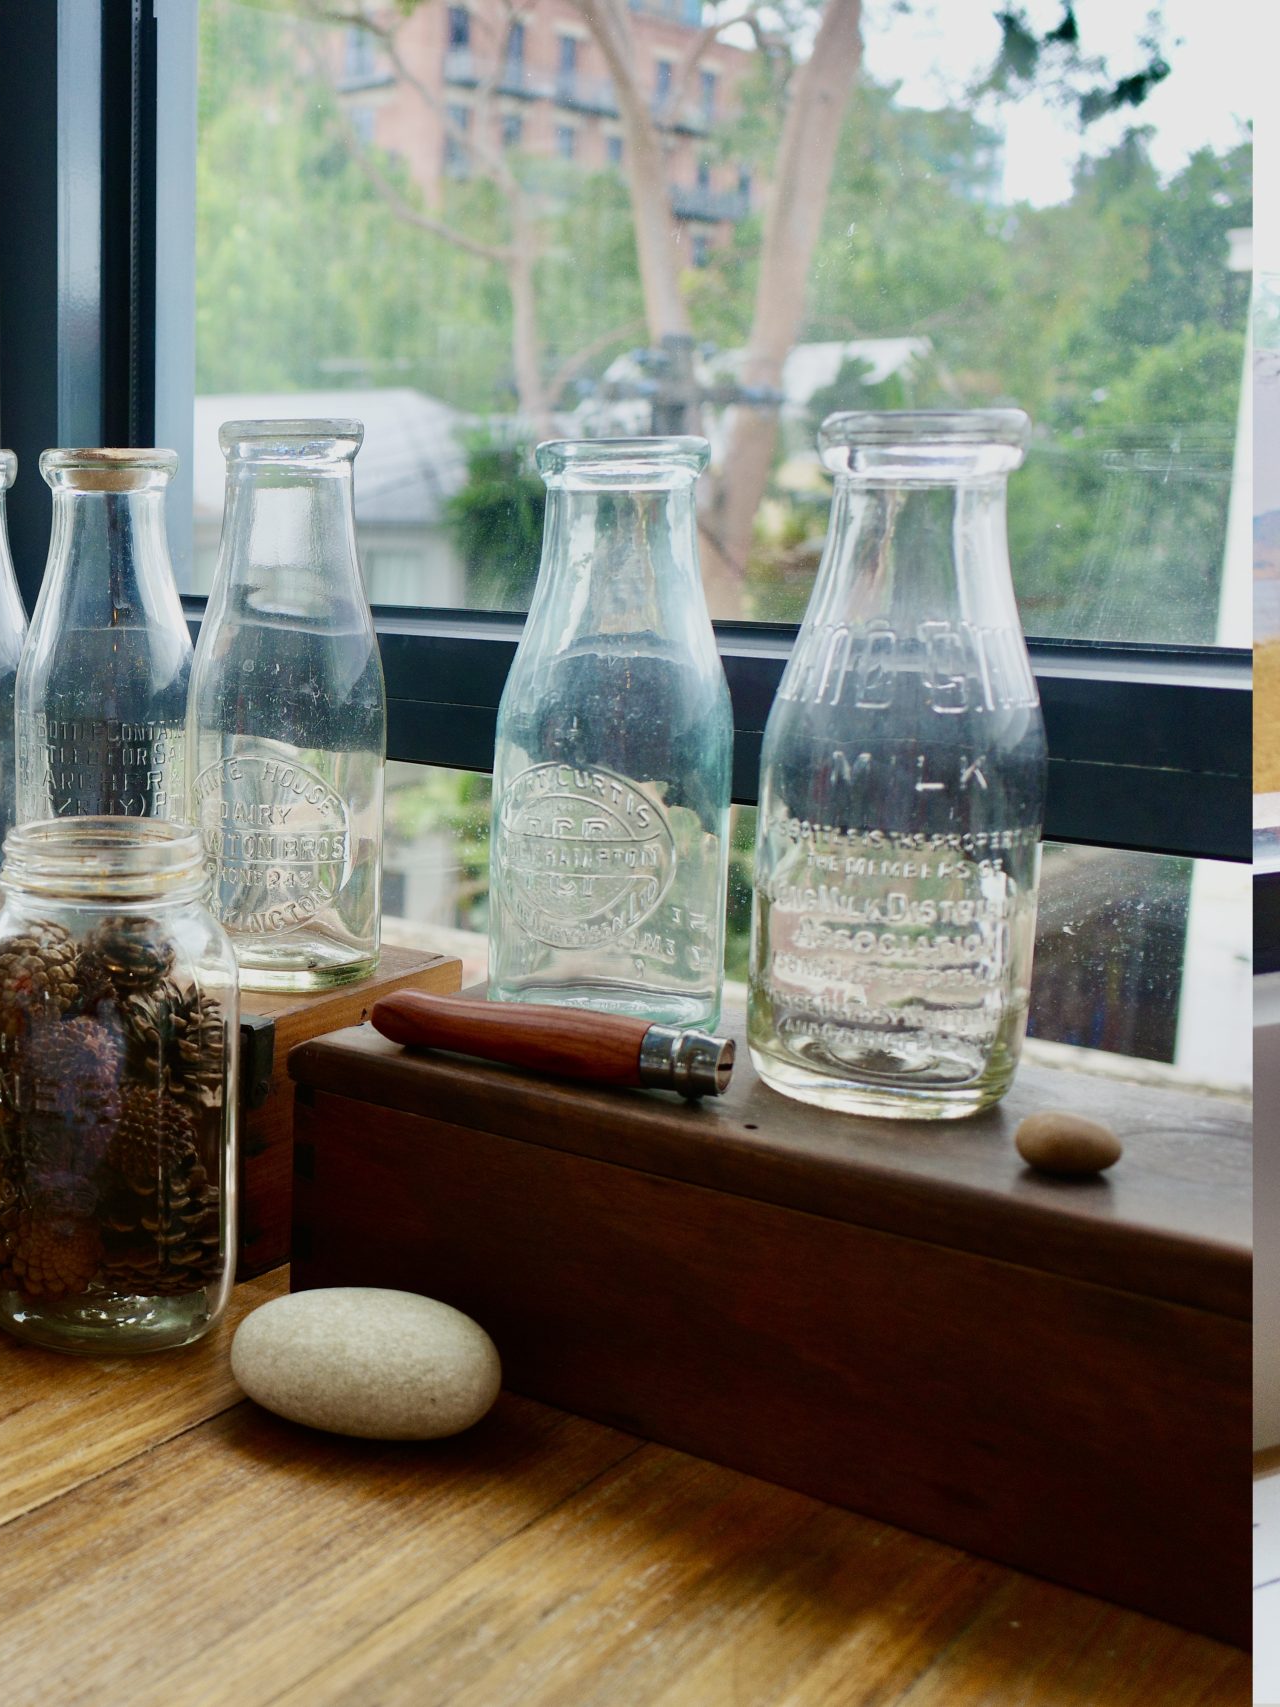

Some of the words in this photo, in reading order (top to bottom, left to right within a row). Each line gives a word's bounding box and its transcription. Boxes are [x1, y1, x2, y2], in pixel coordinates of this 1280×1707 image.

[830, 751, 988, 791] MILK
[261, 762, 340, 818] HOUSE
[556, 764, 651, 829] CURTIS
[218, 801, 293, 826] DAIRY
[282, 835, 346, 861] BROS
[807, 855, 839, 873] THE
[844, 856, 973, 881] MEMBERS
